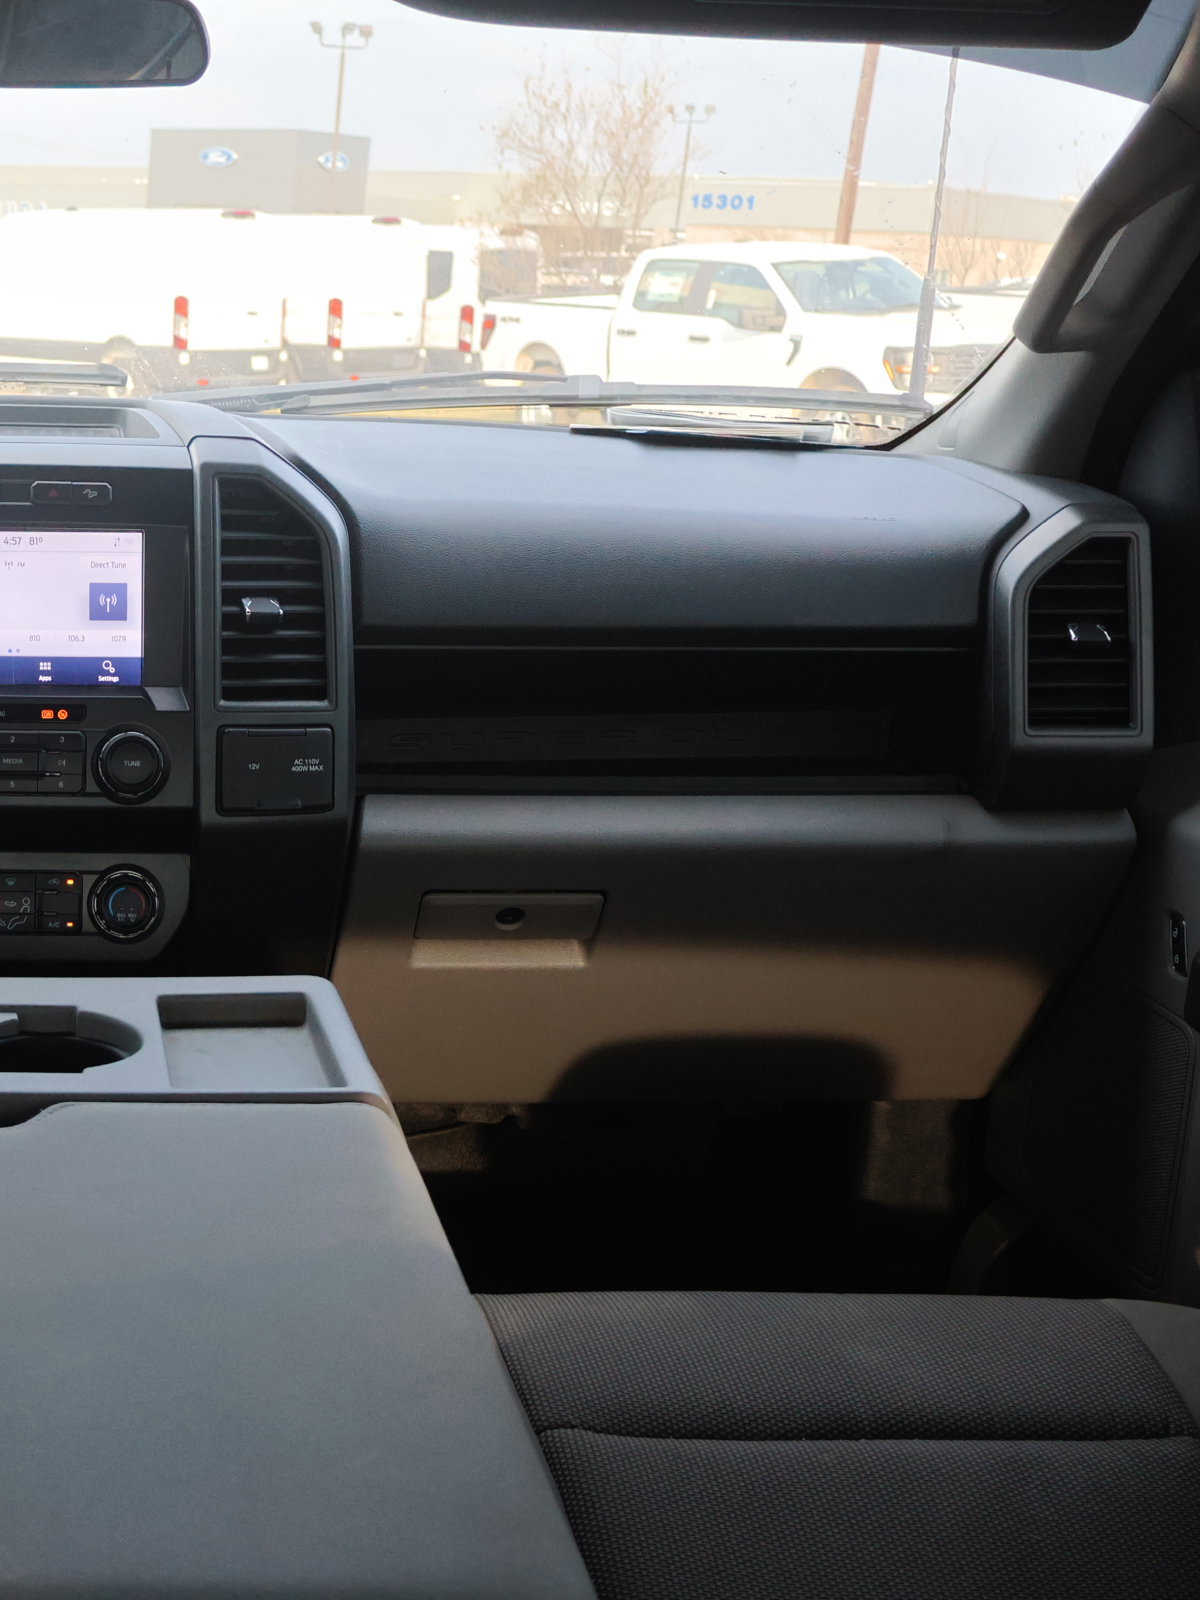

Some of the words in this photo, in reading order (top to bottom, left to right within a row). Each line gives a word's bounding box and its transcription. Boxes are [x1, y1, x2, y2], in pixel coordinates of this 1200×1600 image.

[691, 193, 756, 210] 15301
[3, 536, 22, 546] 4:57
[90, 561, 109, 569] Direct
[110, 561, 127, 569] Tune
[29, 634, 41, 642] 810
[68, 634, 85, 642] 106.3
[111, 635, 127, 643] 107.9
[38, 675, 52, 683] Apps
[98, 675, 120, 683] Settings
